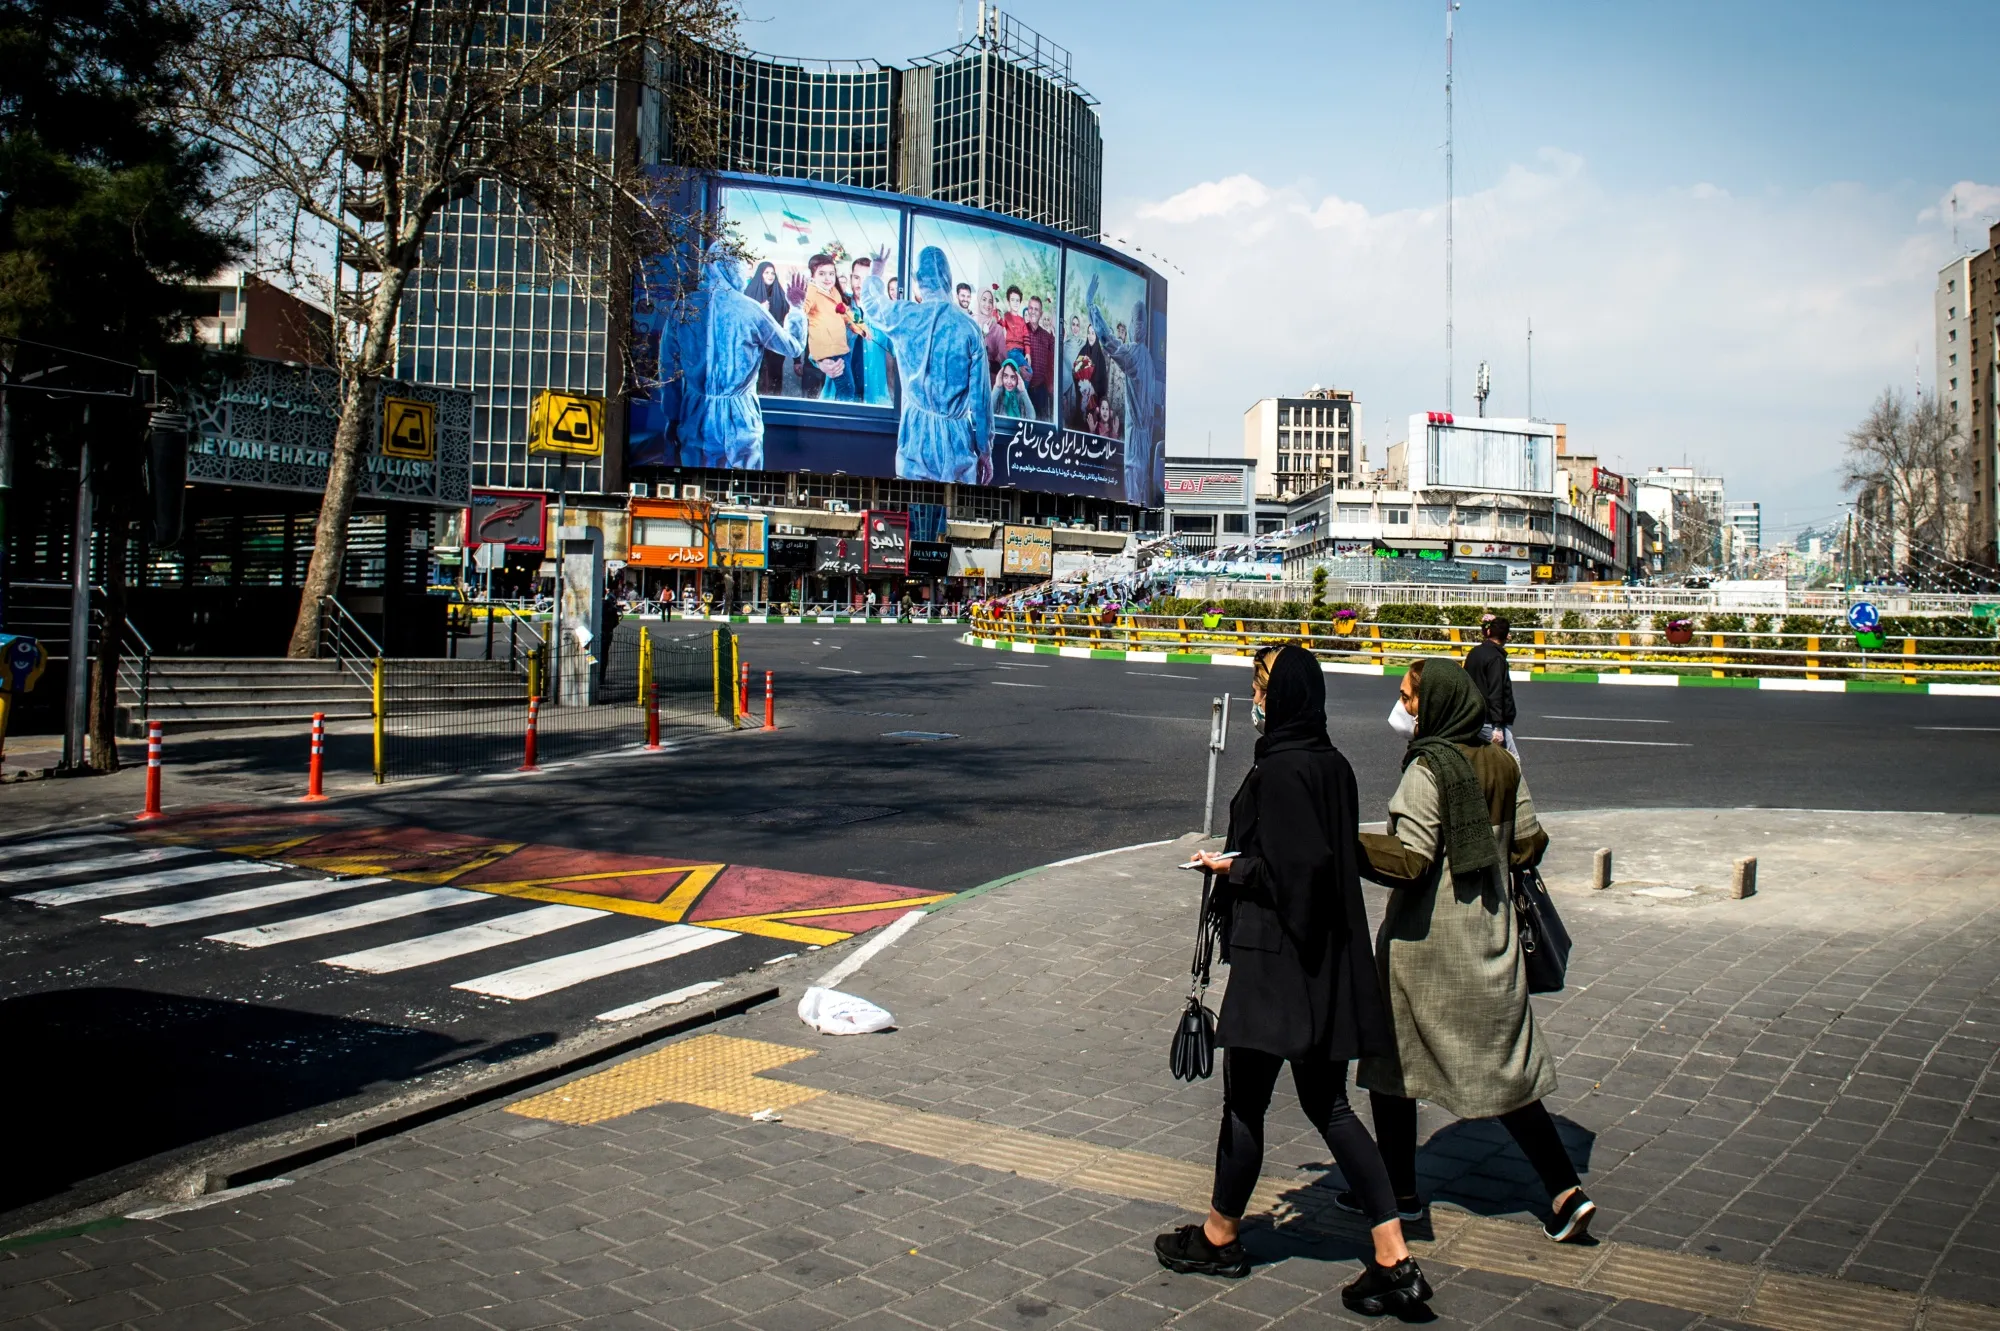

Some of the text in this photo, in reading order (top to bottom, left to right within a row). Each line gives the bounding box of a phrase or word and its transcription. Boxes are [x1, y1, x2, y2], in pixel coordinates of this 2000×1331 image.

[271, 391, 320, 415] حضرت
[1006, 421, 1040, 476] رسانیم
[1037, 430, 1054, 459] می
[1050, 432, 1077, 465] ایران
[1080, 434, 1088, 457] را
[1087, 438, 1117, 461] سلامت
[366, 456, 430, 478] VALIASR
[1011, 462, 1020, 470] داد
[1019, 464, 1036, 473] خواهیم
[1036, 466, 1056, 475] شکست
[1059, 468, 1070, 478] کرونا
[870, 533, 905, 550] بامبو
[1006, 530, 1051, 550] پریسا تن پوش
[631, 551, 642, 560] 36
[668, 547, 704, 563] دیدار
